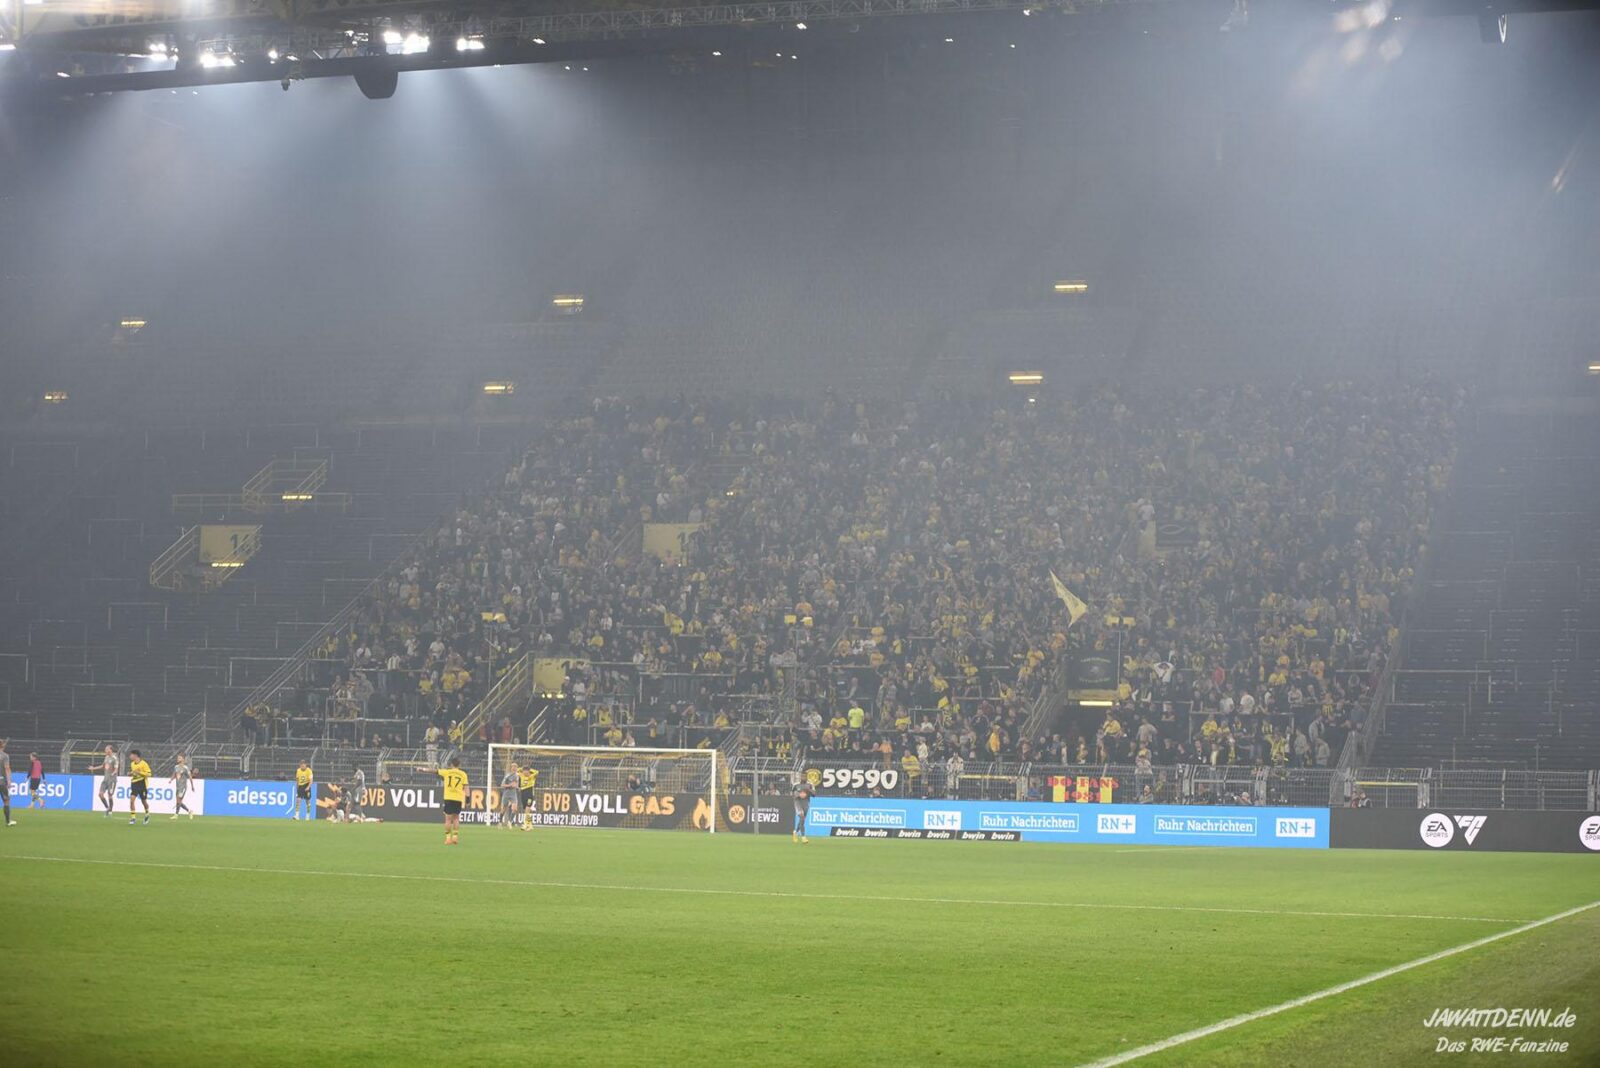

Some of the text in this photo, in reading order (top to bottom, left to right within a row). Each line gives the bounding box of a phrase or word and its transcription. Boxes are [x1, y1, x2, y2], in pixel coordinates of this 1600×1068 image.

[448, 775, 461, 788] 17
[823, 768, 898, 790] 59590
[9, 780, 65, 797] adsso
[116, 786, 173, 801] asso
[228, 786, 287, 806] adesso
[360, 788, 386, 806] BVB
[390, 788, 440, 808] VOLL
[543, 793, 570, 812] BVB
[575, 794, 628, 814] VOLL
[629, 795, 675, 816] GAS
[459, 811, 475, 822] ETZT
[543, 813, 598, 826] DEW21.DE/BVB
[813, 810, 903, 825] Ruhr Nachrichten
[927, 814, 958, 826] RN+
[983, 816, 1076, 829] Ruhr Nachrichten
[1101, 818, 1132, 830] RN+
[1158, 818, 1253, 832] Ruhr Nachrichten
[1279, 822, 1312, 834] RN+
[1427, 821, 1447, 832] EA
[836, 828, 888, 838] bwin bwin
[898, 830, 950, 839] bwin bwin
[962, 831, 1014, 840] bwin bwin
